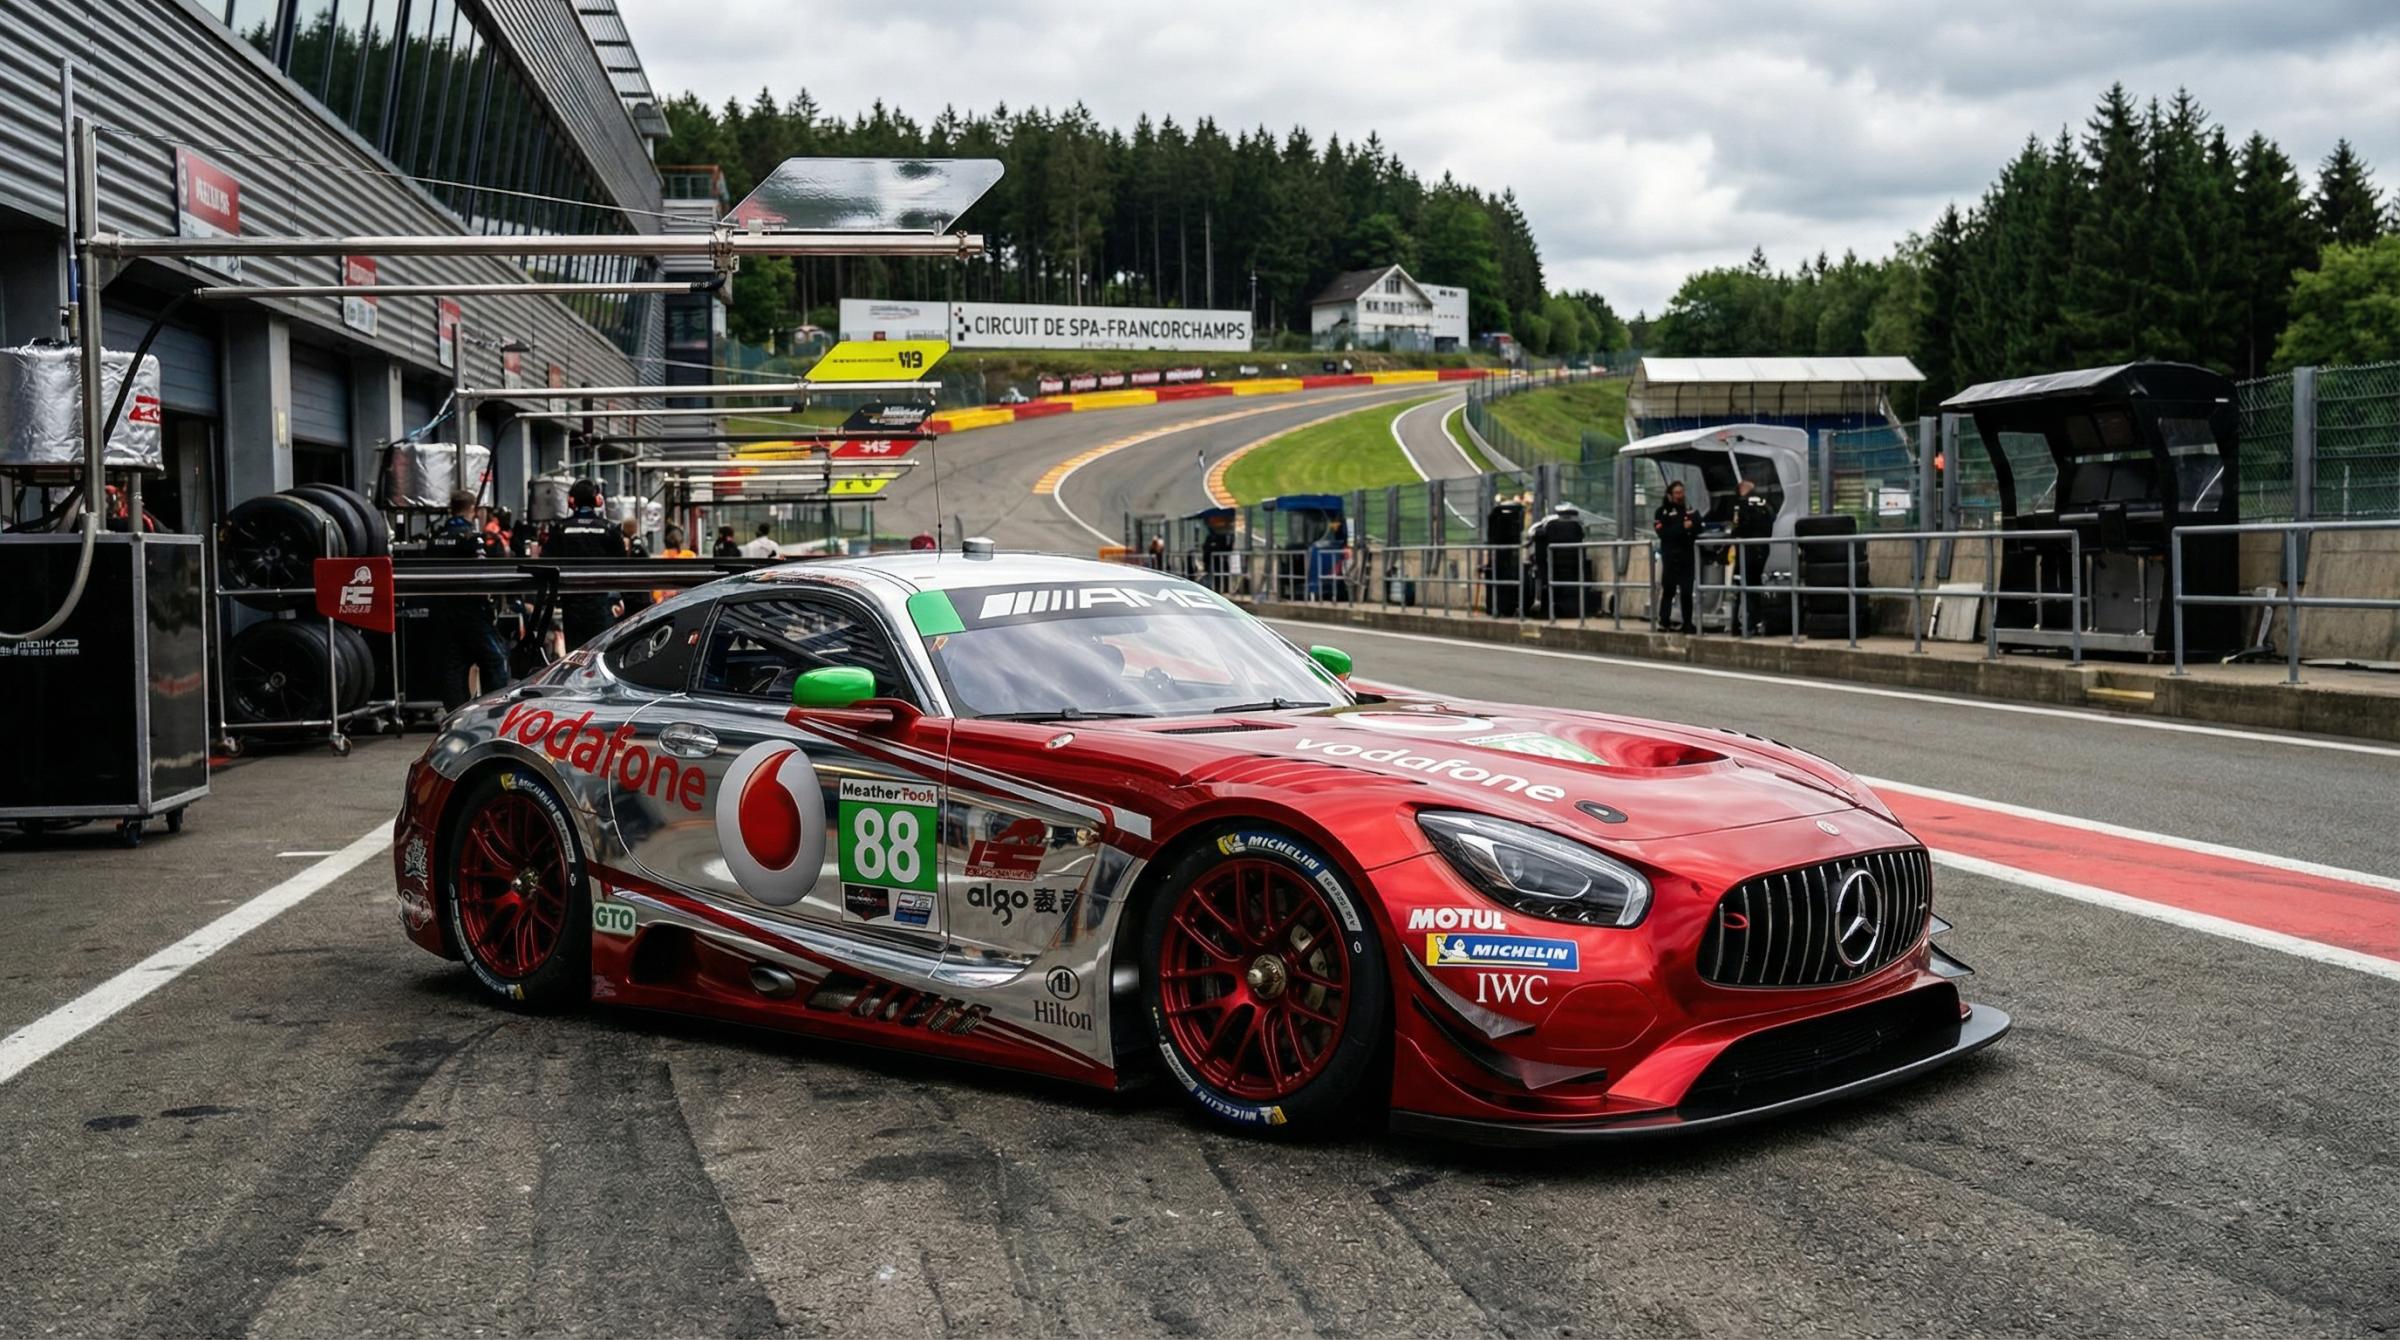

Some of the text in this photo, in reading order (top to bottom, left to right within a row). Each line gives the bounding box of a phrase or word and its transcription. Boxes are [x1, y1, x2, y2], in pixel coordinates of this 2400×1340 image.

[975, 316, 1246, 340] CIRCUIT DE SPA-FRANCORCHAMPS
[499, 703, 707, 812] vodafone
[1294, 738, 1567, 802] vodafone
[854, 808, 921, 883] 88
[1247, 835, 1320, 870] MICHELIN
[967, 883, 1029, 927] algo
[1407, 907, 1507, 931] MOTUL
[1472, 944, 1569, 961] MICHELIN
[1476, 972, 1549, 1006] IWC
[1034, 1000, 1093, 1032] Hilton
